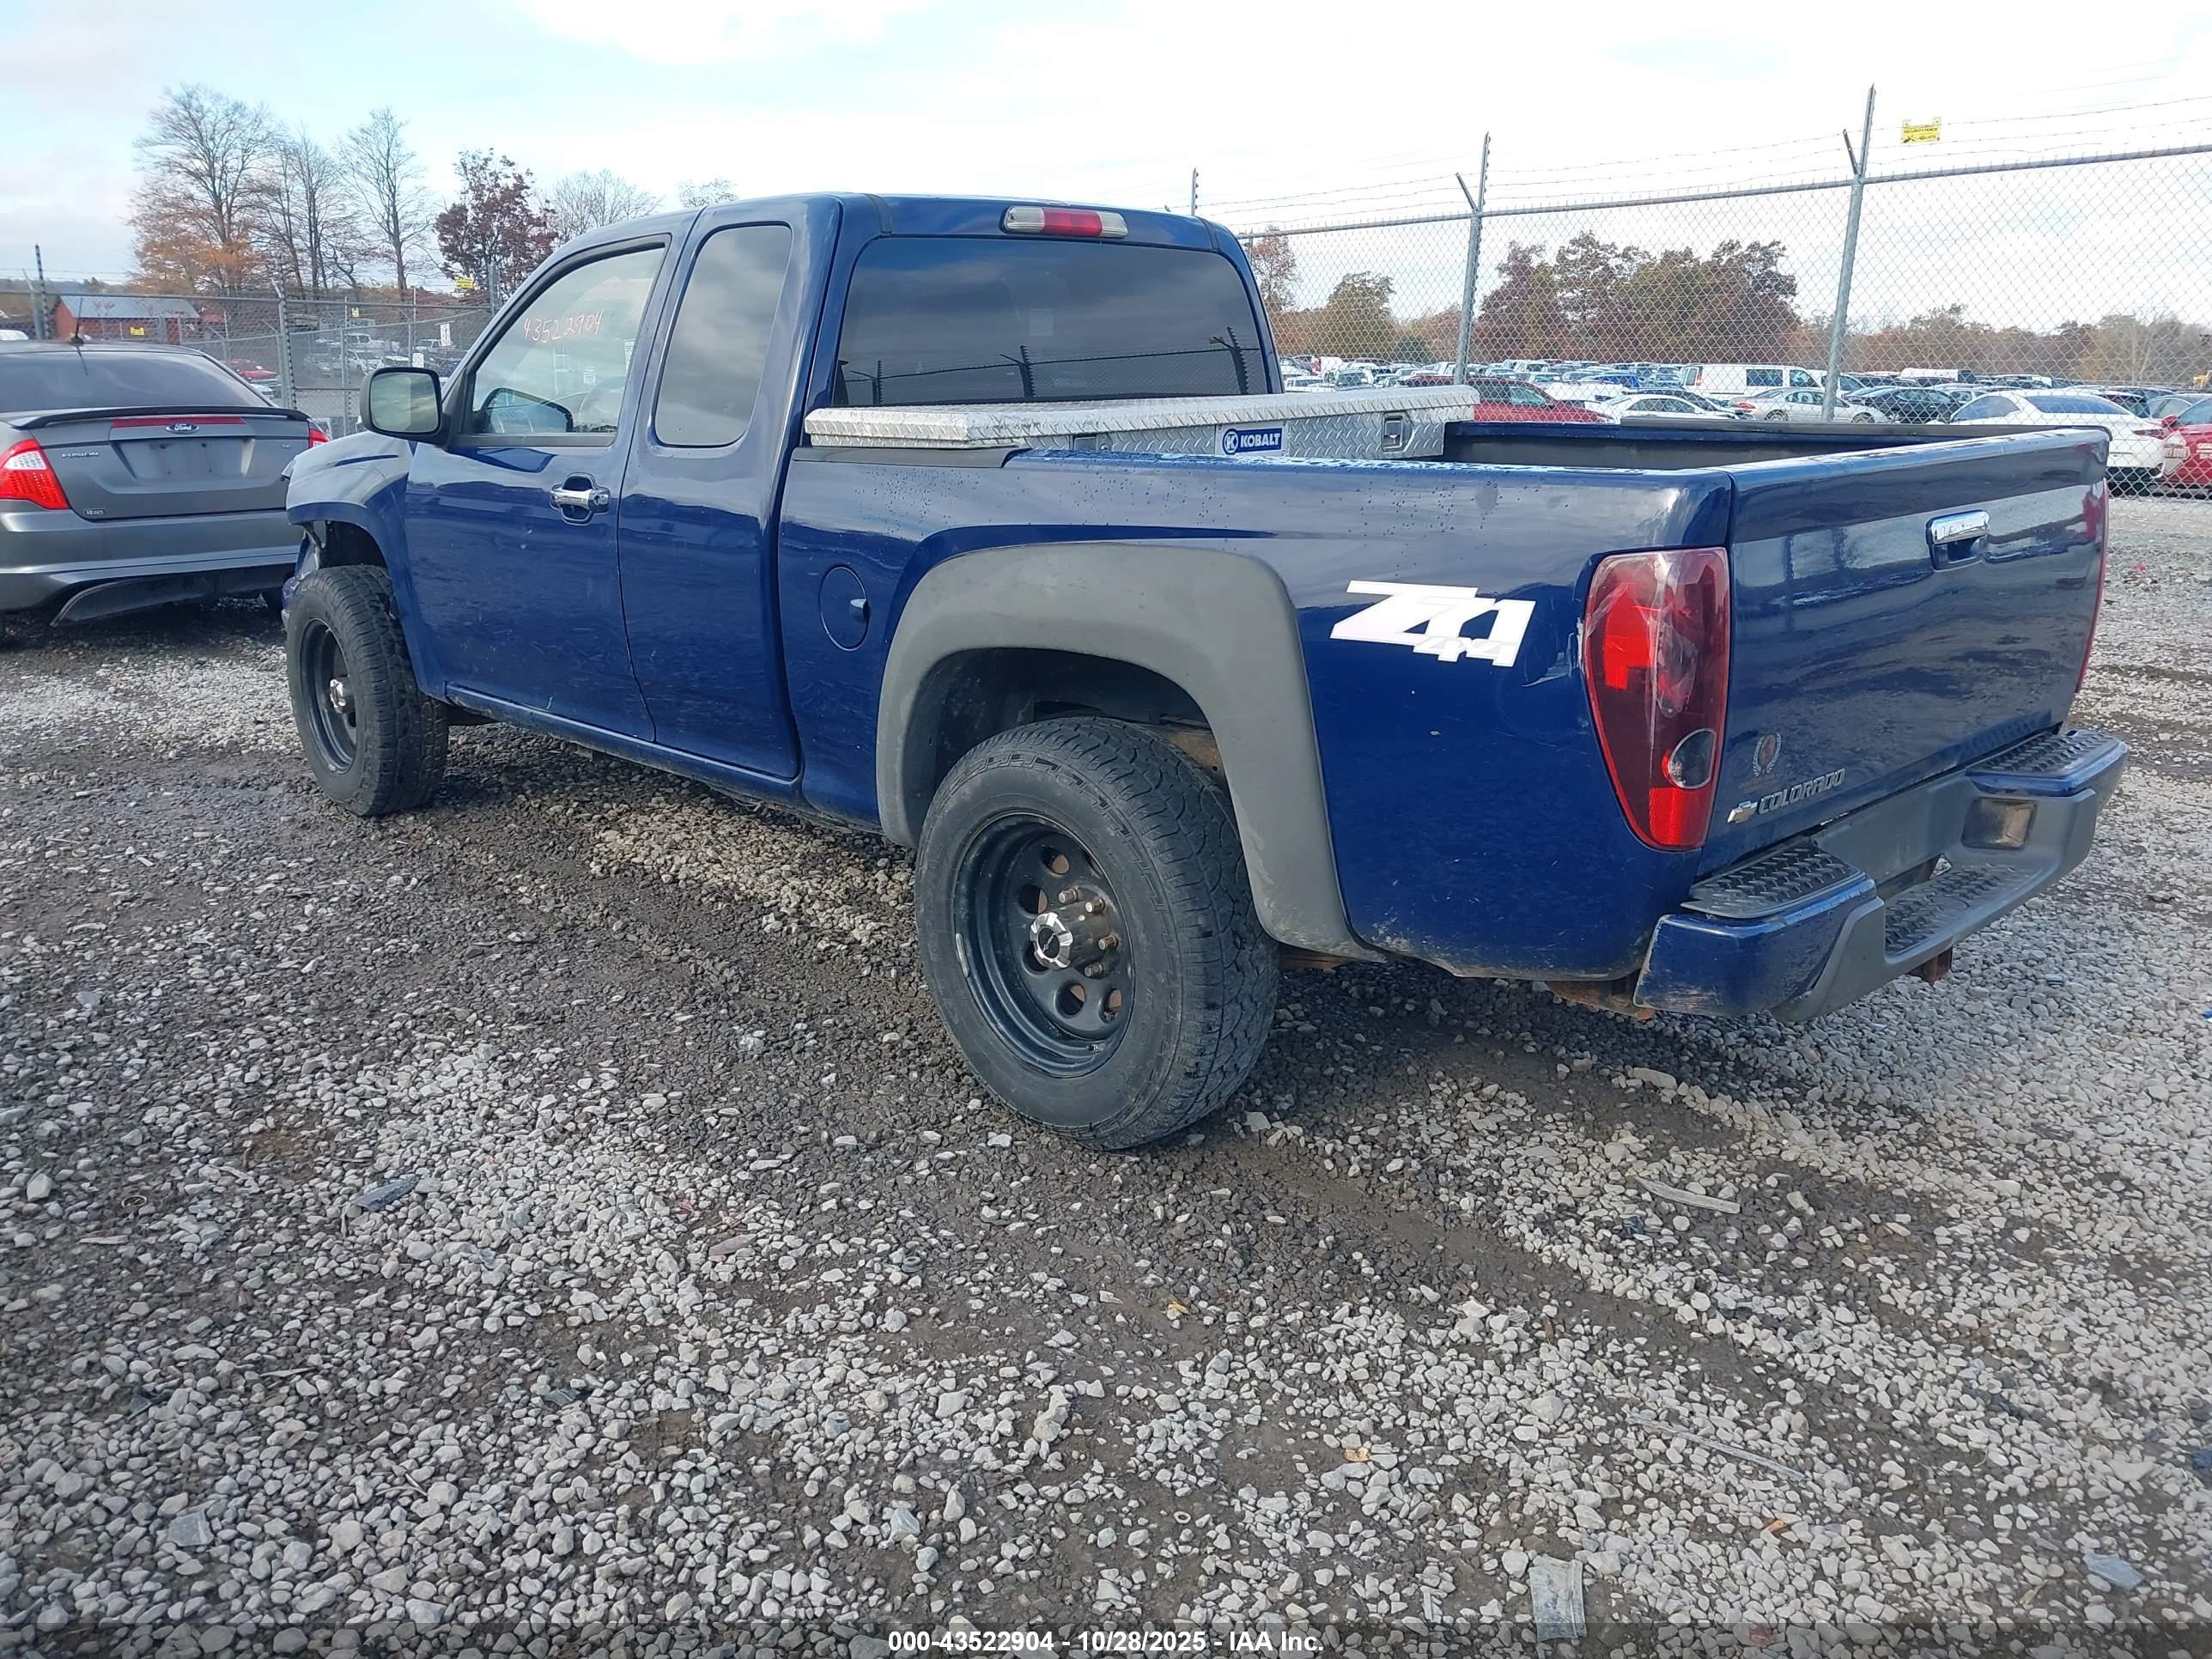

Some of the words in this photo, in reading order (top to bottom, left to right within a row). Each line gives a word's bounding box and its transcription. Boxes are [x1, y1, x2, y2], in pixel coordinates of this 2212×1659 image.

[1240, 432, 1280, 448] KOBALT
[1329, 580, 1537, 648] Z71
[1759, 768, 1846, 815] COLORADO
